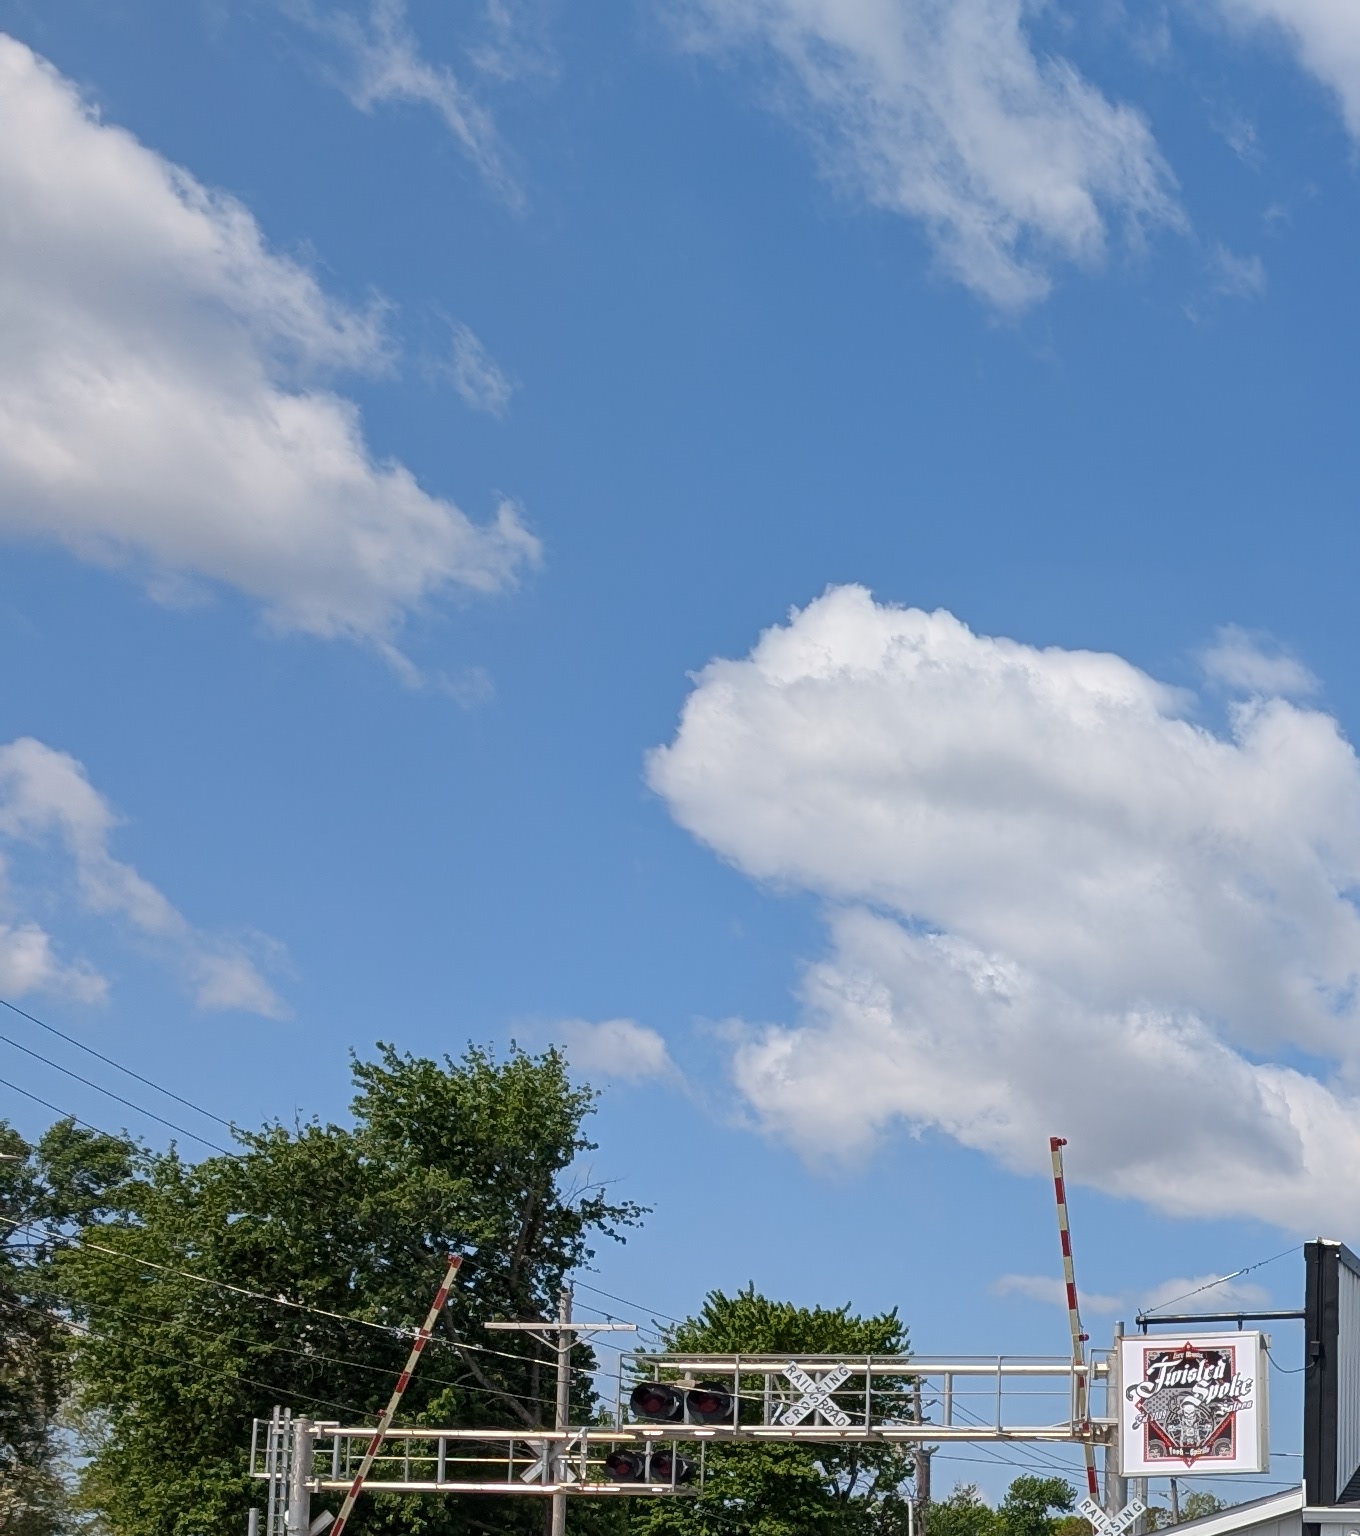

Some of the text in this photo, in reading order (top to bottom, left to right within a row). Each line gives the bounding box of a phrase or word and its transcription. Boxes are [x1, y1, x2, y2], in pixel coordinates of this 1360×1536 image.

[784, 1366, 849, 1426] CROSSING
[1126, 1356, 1226, 1402] Twisted
[1181, 1371, 1254, 1407] Spoke
